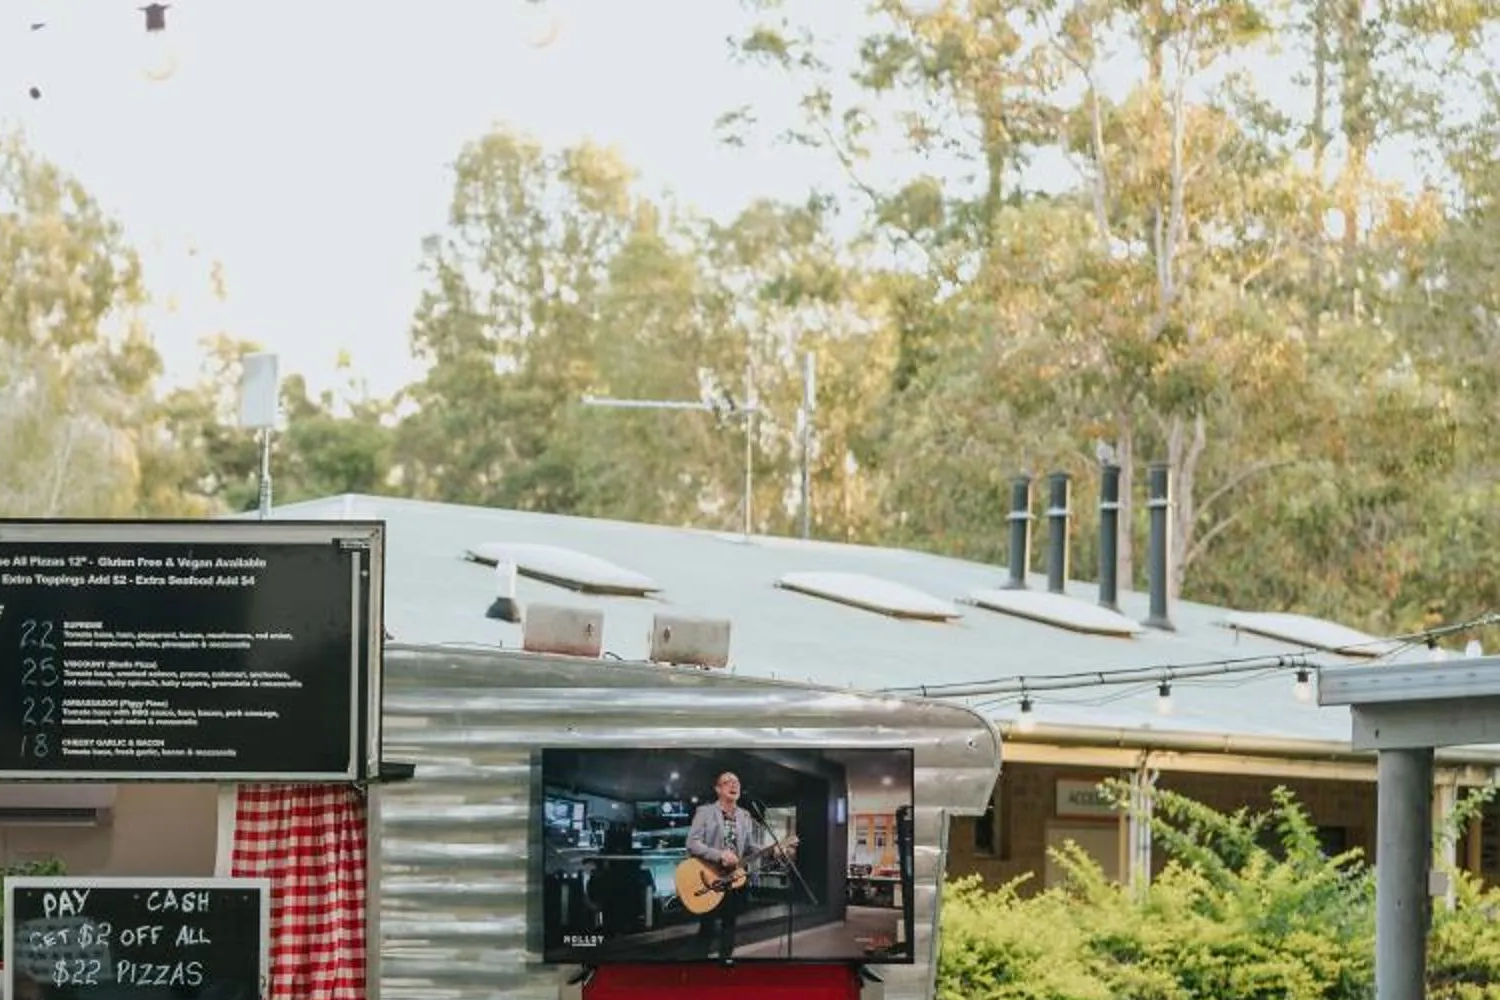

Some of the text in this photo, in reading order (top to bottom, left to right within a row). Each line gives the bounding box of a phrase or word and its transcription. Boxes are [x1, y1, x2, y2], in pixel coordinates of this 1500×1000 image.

[12, 557, 27, 566] All
[29, 557, 65, 566] Pizzas
[68, 557, 86, 566] 12"
[97, 557, 135, 566] Gluten
[137, 558, 162, 566] Free
[177, 559, 212, 568] Vegan
[214, 559, 266, 567] Available
[1, 574, 32, 584] Extra
[34, 576, 84, 585] Toppings
[87, 575, 110, 584] Add
[112, 575, 126, 584] $2
[135, 576, 165, 584] Extra
[167, 576, 214, 585] Seafood
[215, 576, 238, 585] Add
[240, 576, 255, 585] $4
[20, 619, 57, 651] 22
[22, 696, 56, 726] 22
[43, 888, 210, 920] PAY CASH
[77, 922, 112, 950] $2
[120, 926, 164, 948] OFF
[175, 924, 212, 948] ALL
[51, 955, 204, 988] $22 PIZZAS
